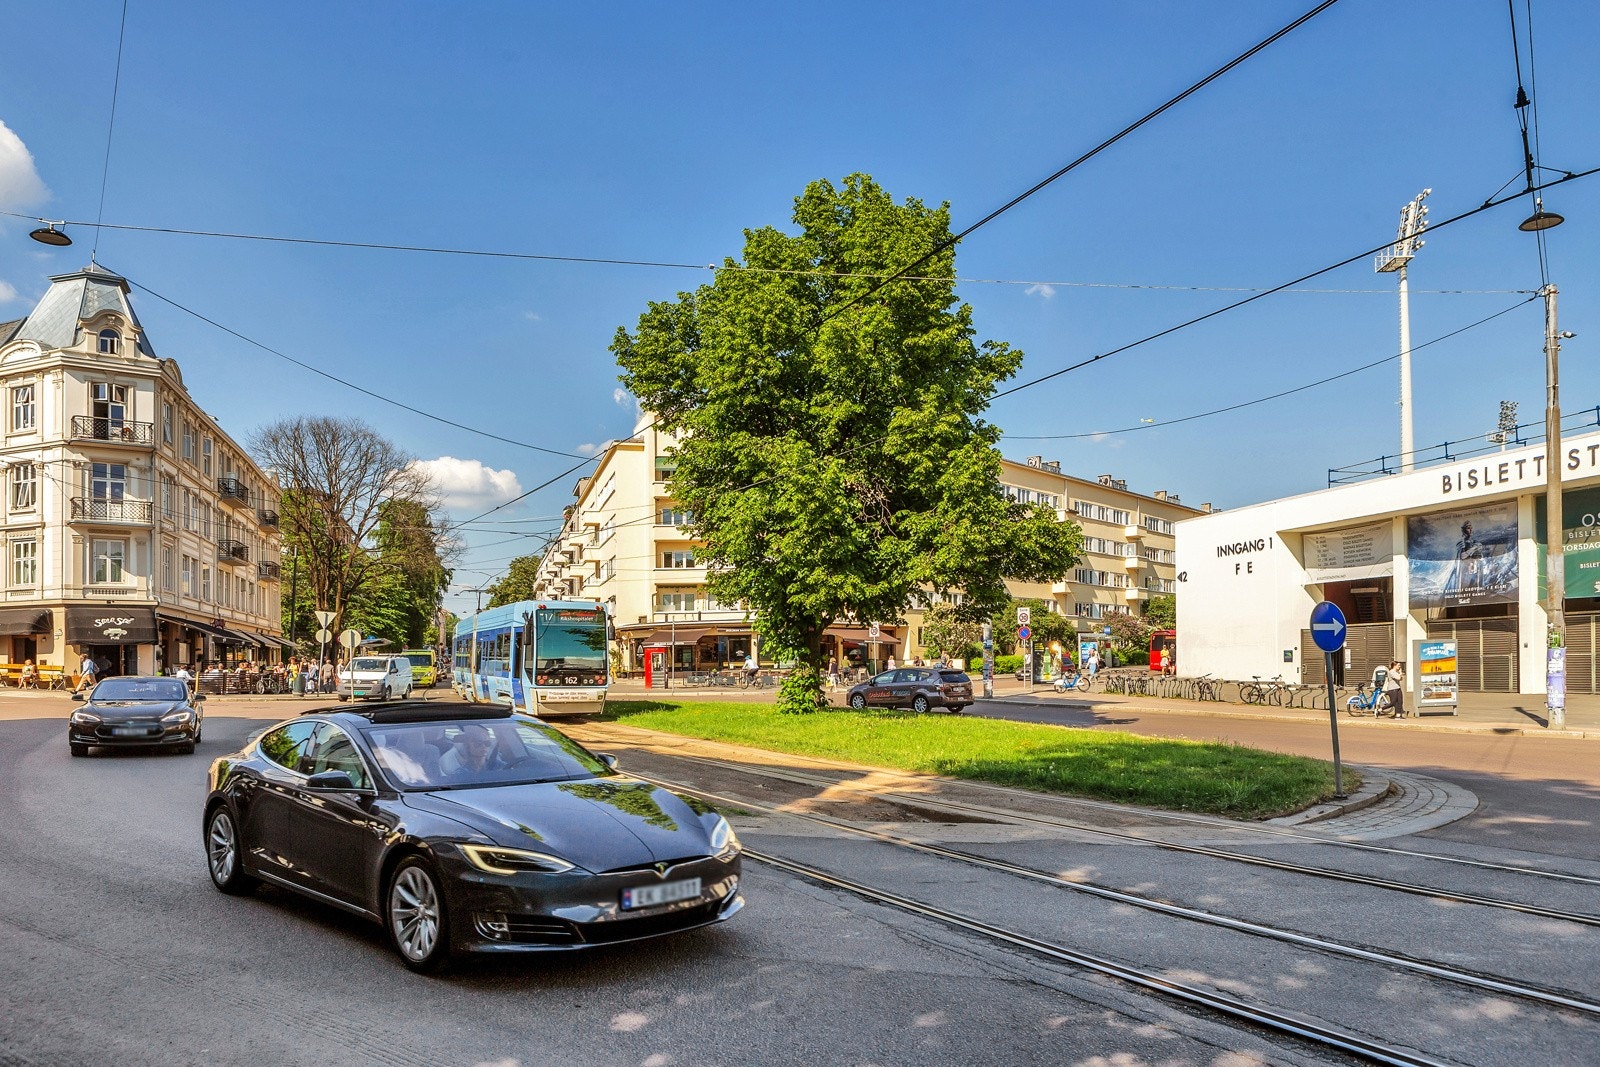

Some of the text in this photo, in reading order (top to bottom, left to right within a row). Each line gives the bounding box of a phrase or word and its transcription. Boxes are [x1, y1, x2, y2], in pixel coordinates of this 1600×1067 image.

[1442, 444, 1600, 494] BISLETT ST
[1216, 537, 1273, 558] INNGANG 1
[1562, 541, 1600, 552] TORSDAG
[1235, 561, 1253, 575] F E
[1580, 561, 1600, 569] BISLET
[1182, 571, 1188, 582] 2
[564, 676, 578, 684] 162
